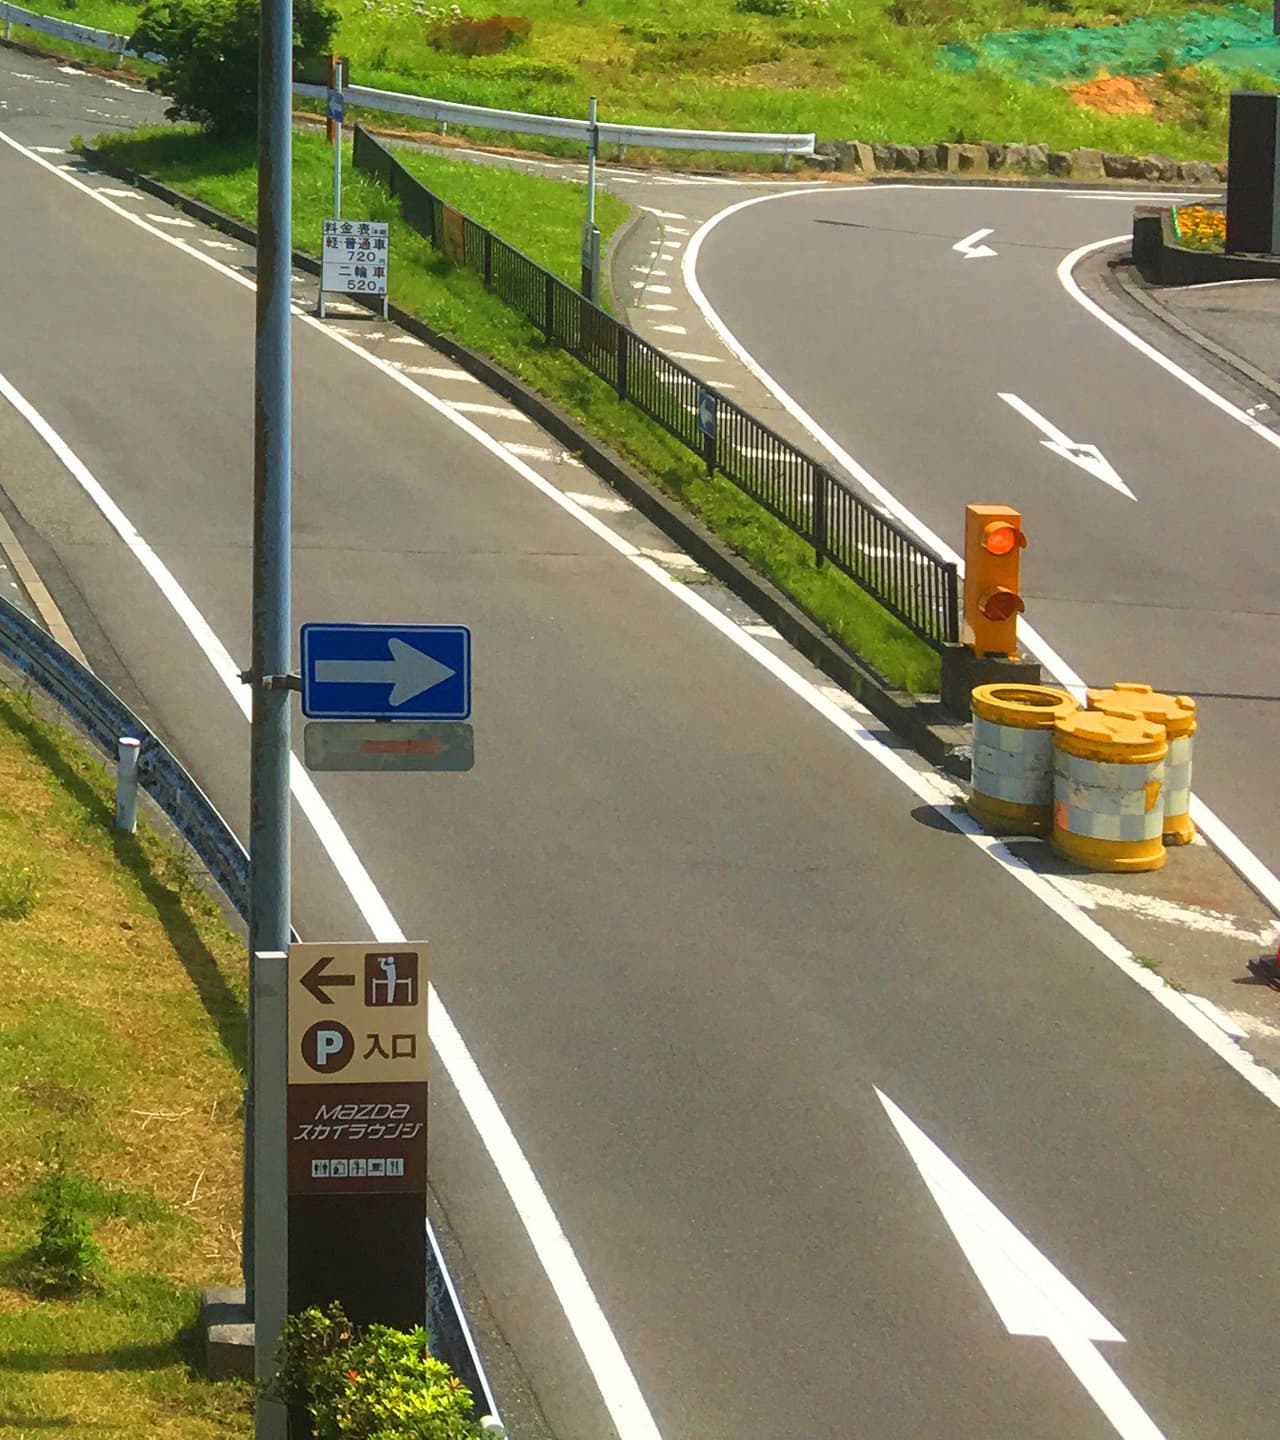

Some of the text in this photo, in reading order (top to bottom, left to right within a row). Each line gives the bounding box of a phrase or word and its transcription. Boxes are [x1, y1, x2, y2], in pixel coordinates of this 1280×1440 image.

[316, 1030, 417, 1065] P 入口
[293, 1123, 423, 1141] スカイラウンジ
